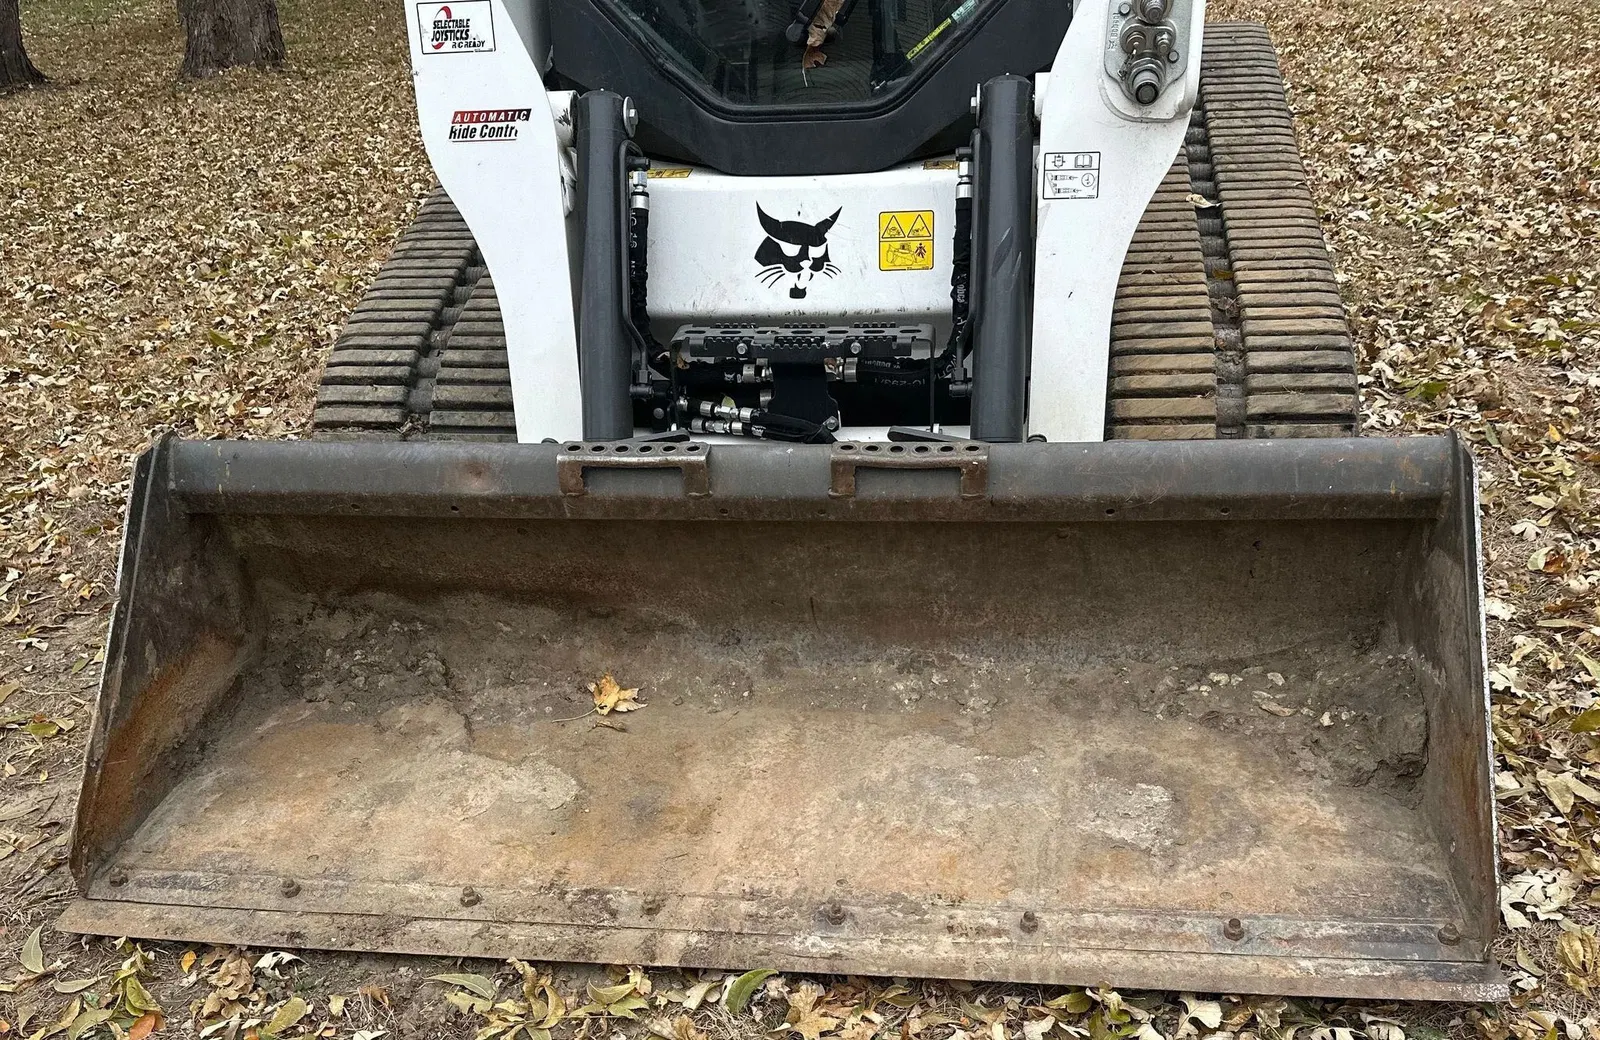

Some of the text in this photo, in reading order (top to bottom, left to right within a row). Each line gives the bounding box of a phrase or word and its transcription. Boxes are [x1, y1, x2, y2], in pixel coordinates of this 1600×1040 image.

[433, 19, 470, 29] SELECTABLE
[431, 29, 469, 42] JOYSTICKS
[454, 110, 528, 123] AUTOMATIC
[480, 124, 518, 139] Contr
